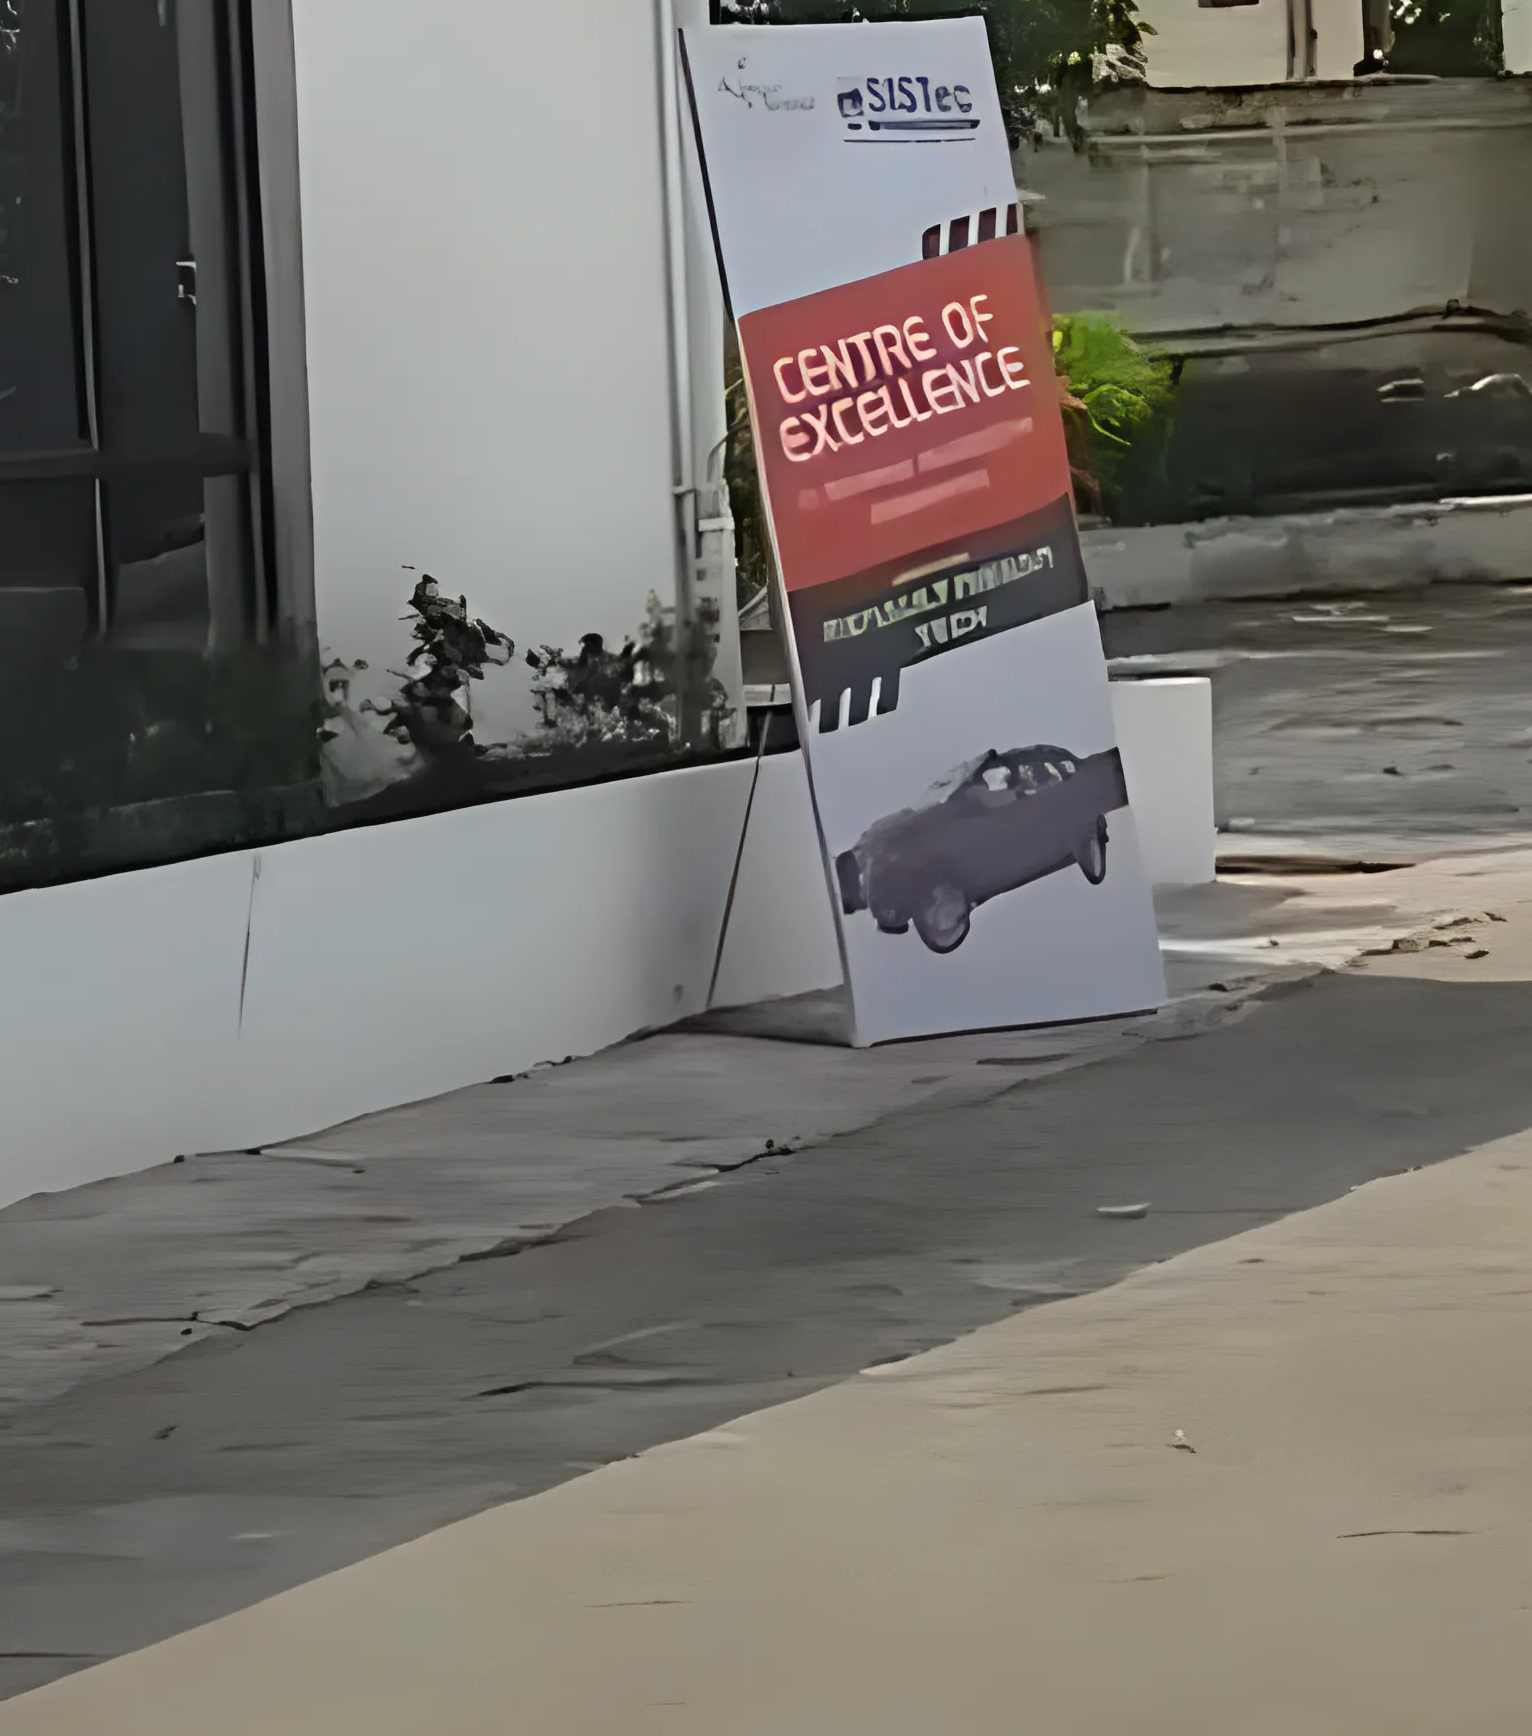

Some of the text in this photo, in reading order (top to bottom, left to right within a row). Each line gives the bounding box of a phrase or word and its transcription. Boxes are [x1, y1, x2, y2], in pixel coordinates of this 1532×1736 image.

[867, 77, 972, 113] SISTec
[773, 294, 993, 404] CENTRE OF
[779, 346, 1030, 462] EXCELLENCE
